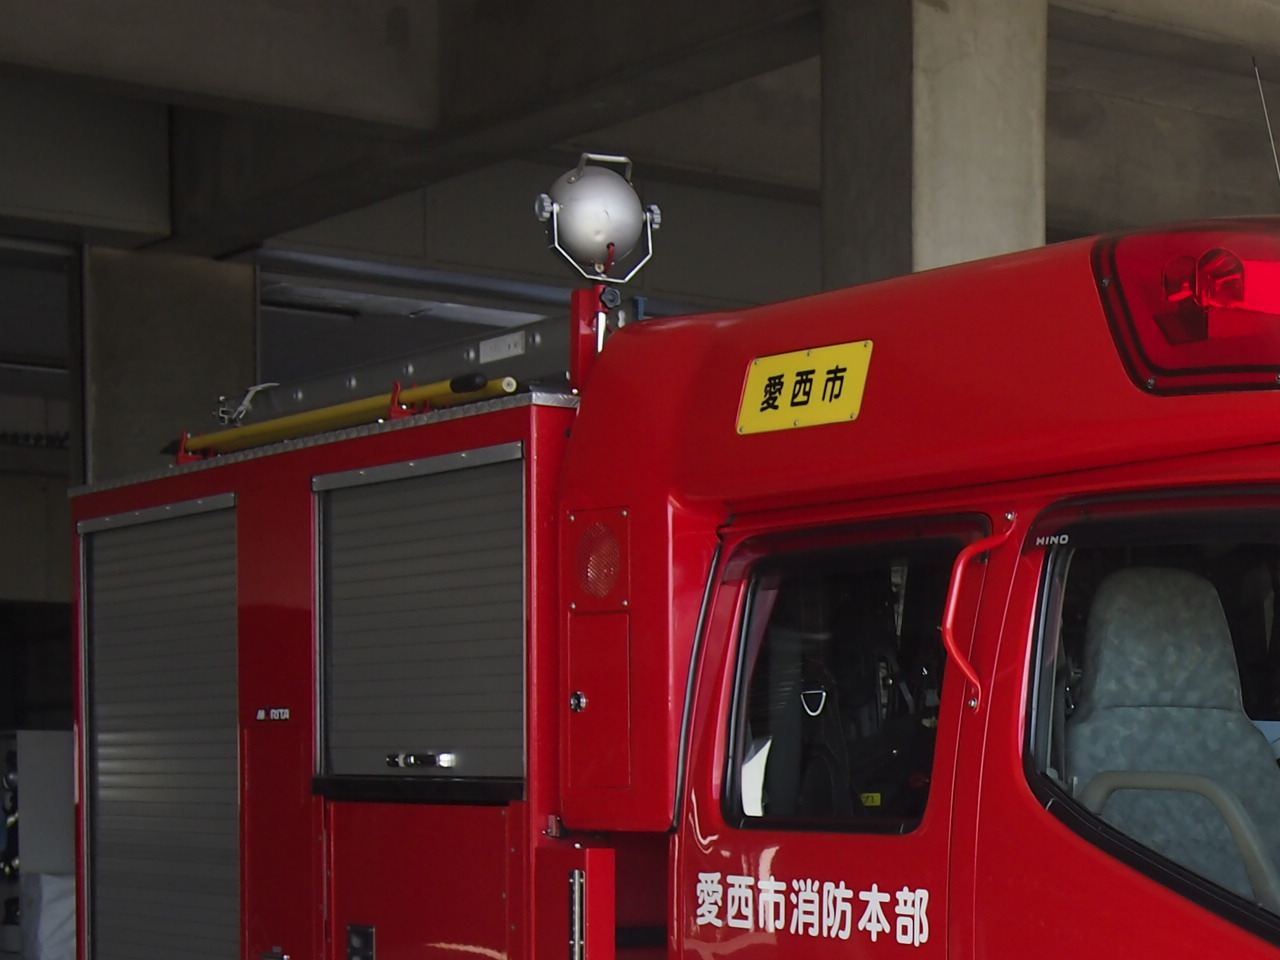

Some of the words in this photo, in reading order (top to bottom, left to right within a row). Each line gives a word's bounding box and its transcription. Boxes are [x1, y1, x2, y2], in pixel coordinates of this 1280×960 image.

[760, 365, 847, 412] 愛西市
[1036, 534, 1069, 546] HINO
[696, 872, 929, 947] 愛西市消防本部
